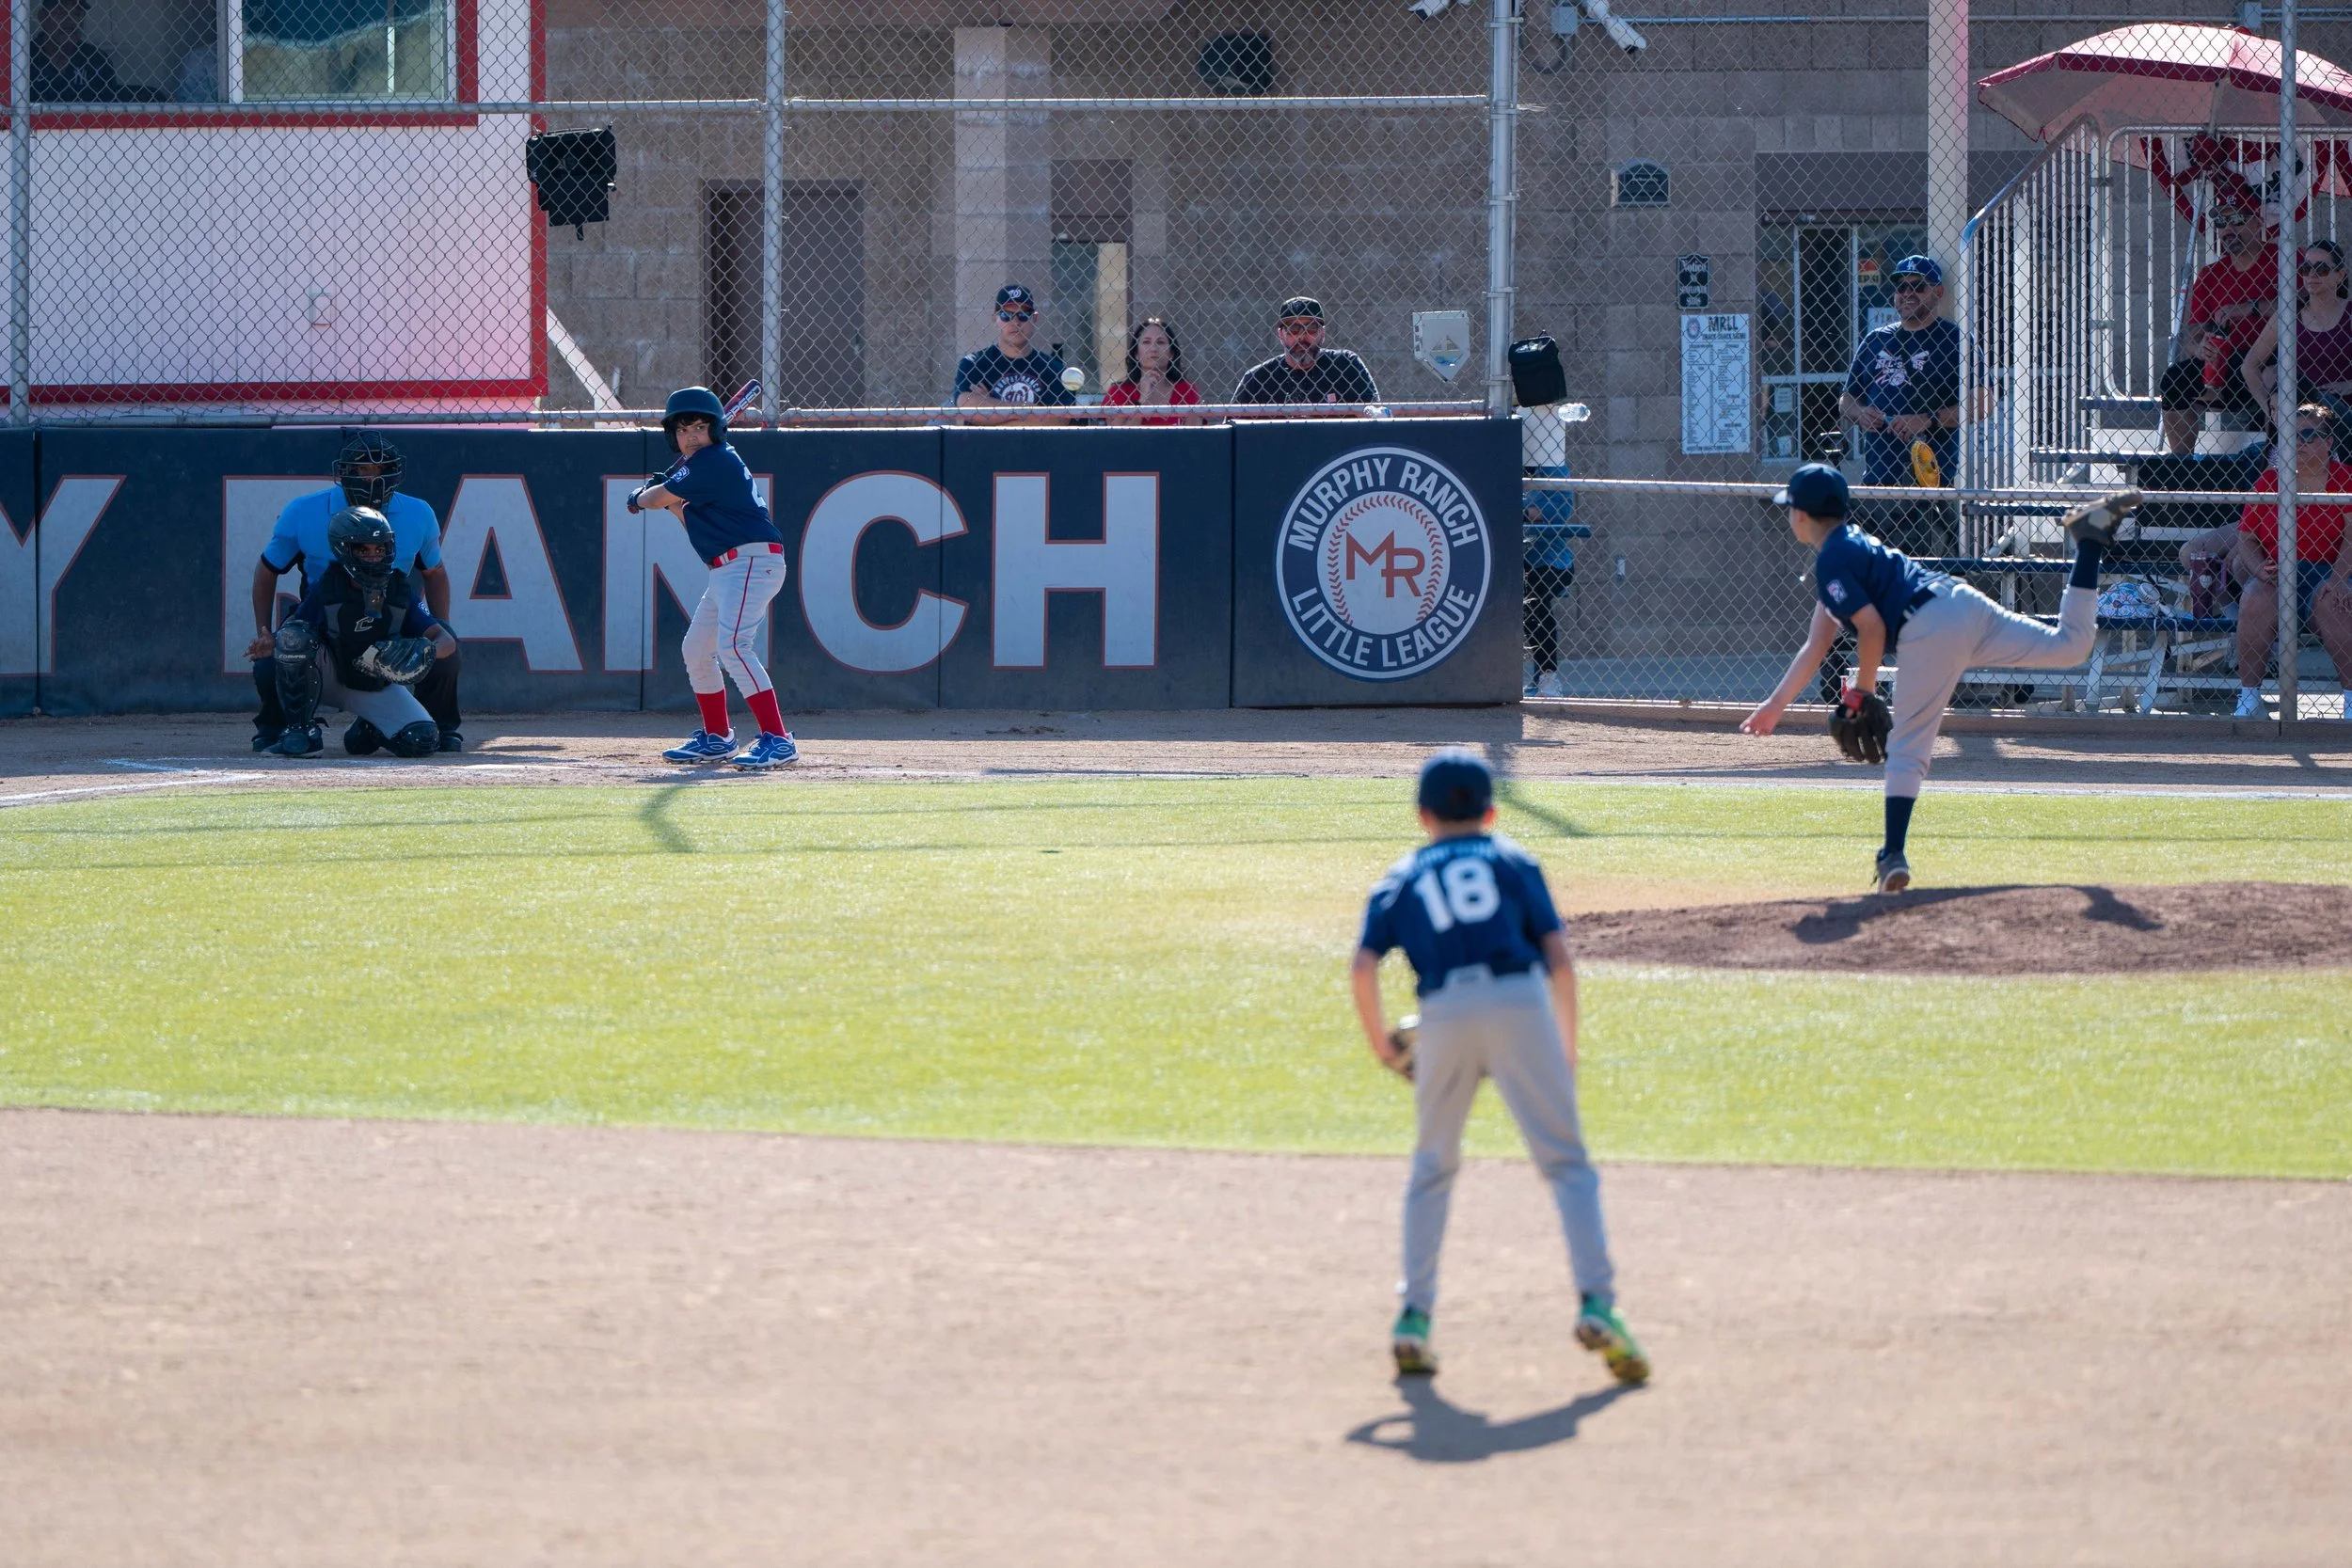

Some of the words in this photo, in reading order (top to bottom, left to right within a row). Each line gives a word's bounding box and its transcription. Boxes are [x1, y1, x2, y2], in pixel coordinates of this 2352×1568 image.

[1858, 274, 1880, 283] EPSI
[1708, 315, 1739, 332] MRLL
[723, 385, 763, 423] SPEED
[1288, 457, 1391, 552] MURPHY
[1399, 461, 1479, 548] RANCH
[1345, 530, 1423, 598] MR
[1292, 586, 1374, 667] LITTLE
[1381, 584, 1475, 668] LEAGUE
[1414, 856, 1502, 933] 18
